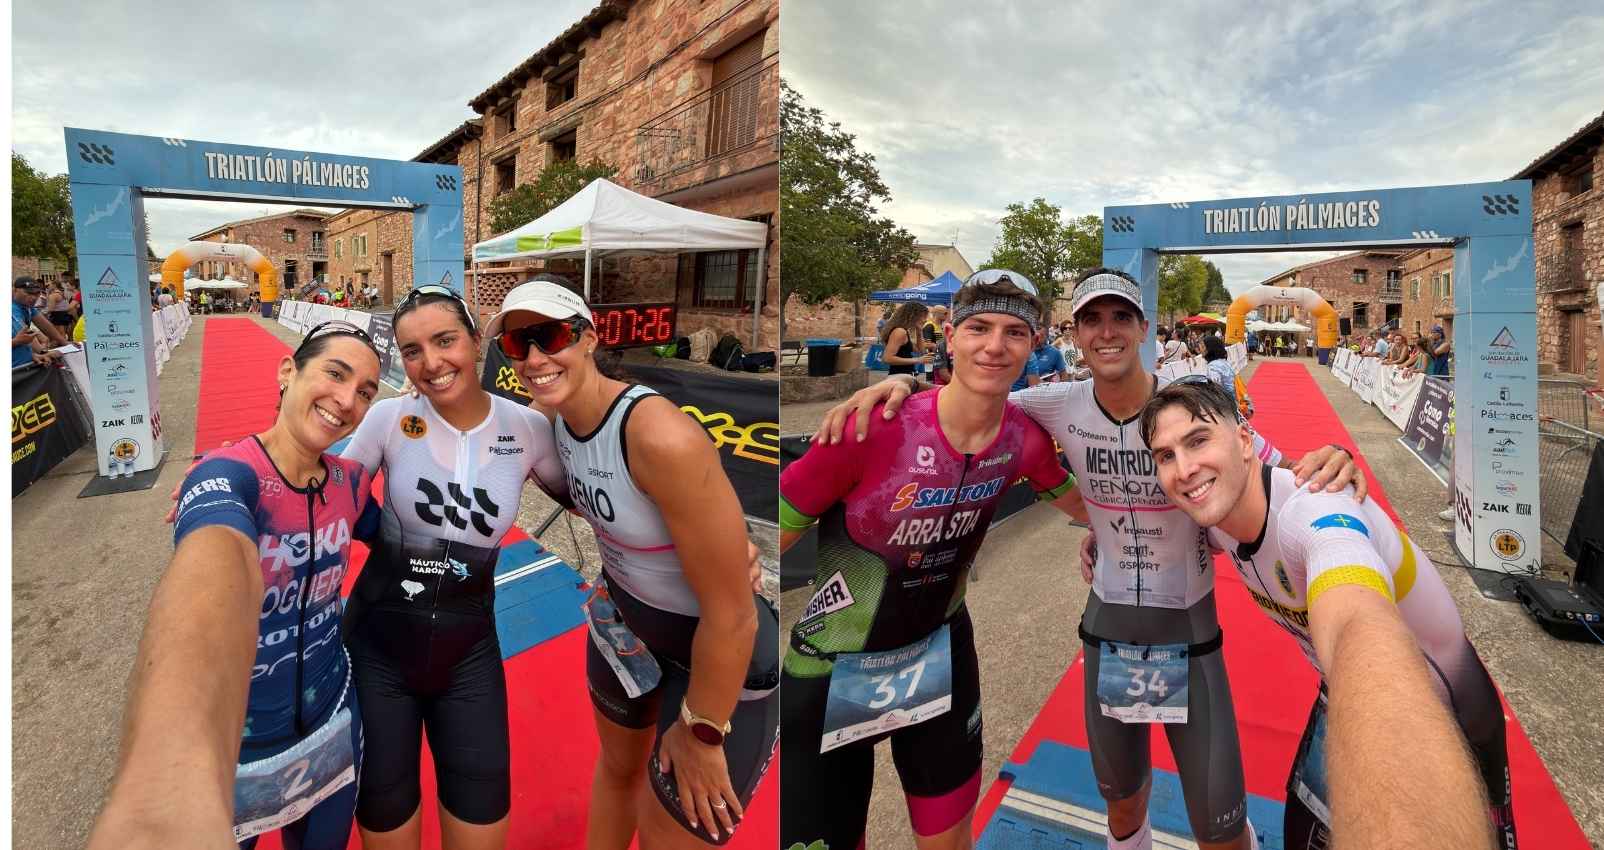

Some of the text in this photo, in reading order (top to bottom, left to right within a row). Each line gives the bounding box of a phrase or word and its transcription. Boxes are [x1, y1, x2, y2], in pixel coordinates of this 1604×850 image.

[205, 151, 370, 189] TRIATLÓN PÁLMACES
[1204, 199, 1380, 234] TRIATLÓN PÁLMACES
[102, 419, 125, 428] ZAIK
[1077, 429, 1107, 441] Opteam
[564, 470, 615, 523] UENO
[912, 476, 1006, 509] SALTOKI
[1089, 476, 1166, 498] PEÑOTA
[1482, 502, 1510, 513] ZAIK
[259, 517, 351, 572] HOKA
[1498, 543, 1517, 552] LTP
[410, 558, 450, 569] NÁUTICO
[1120, 560, 1161, 572] GSPORT
[868, 660, 926, 709] 37
[1126, 667, 1168, 697] 34
[283, 759, 313, 800] 2
